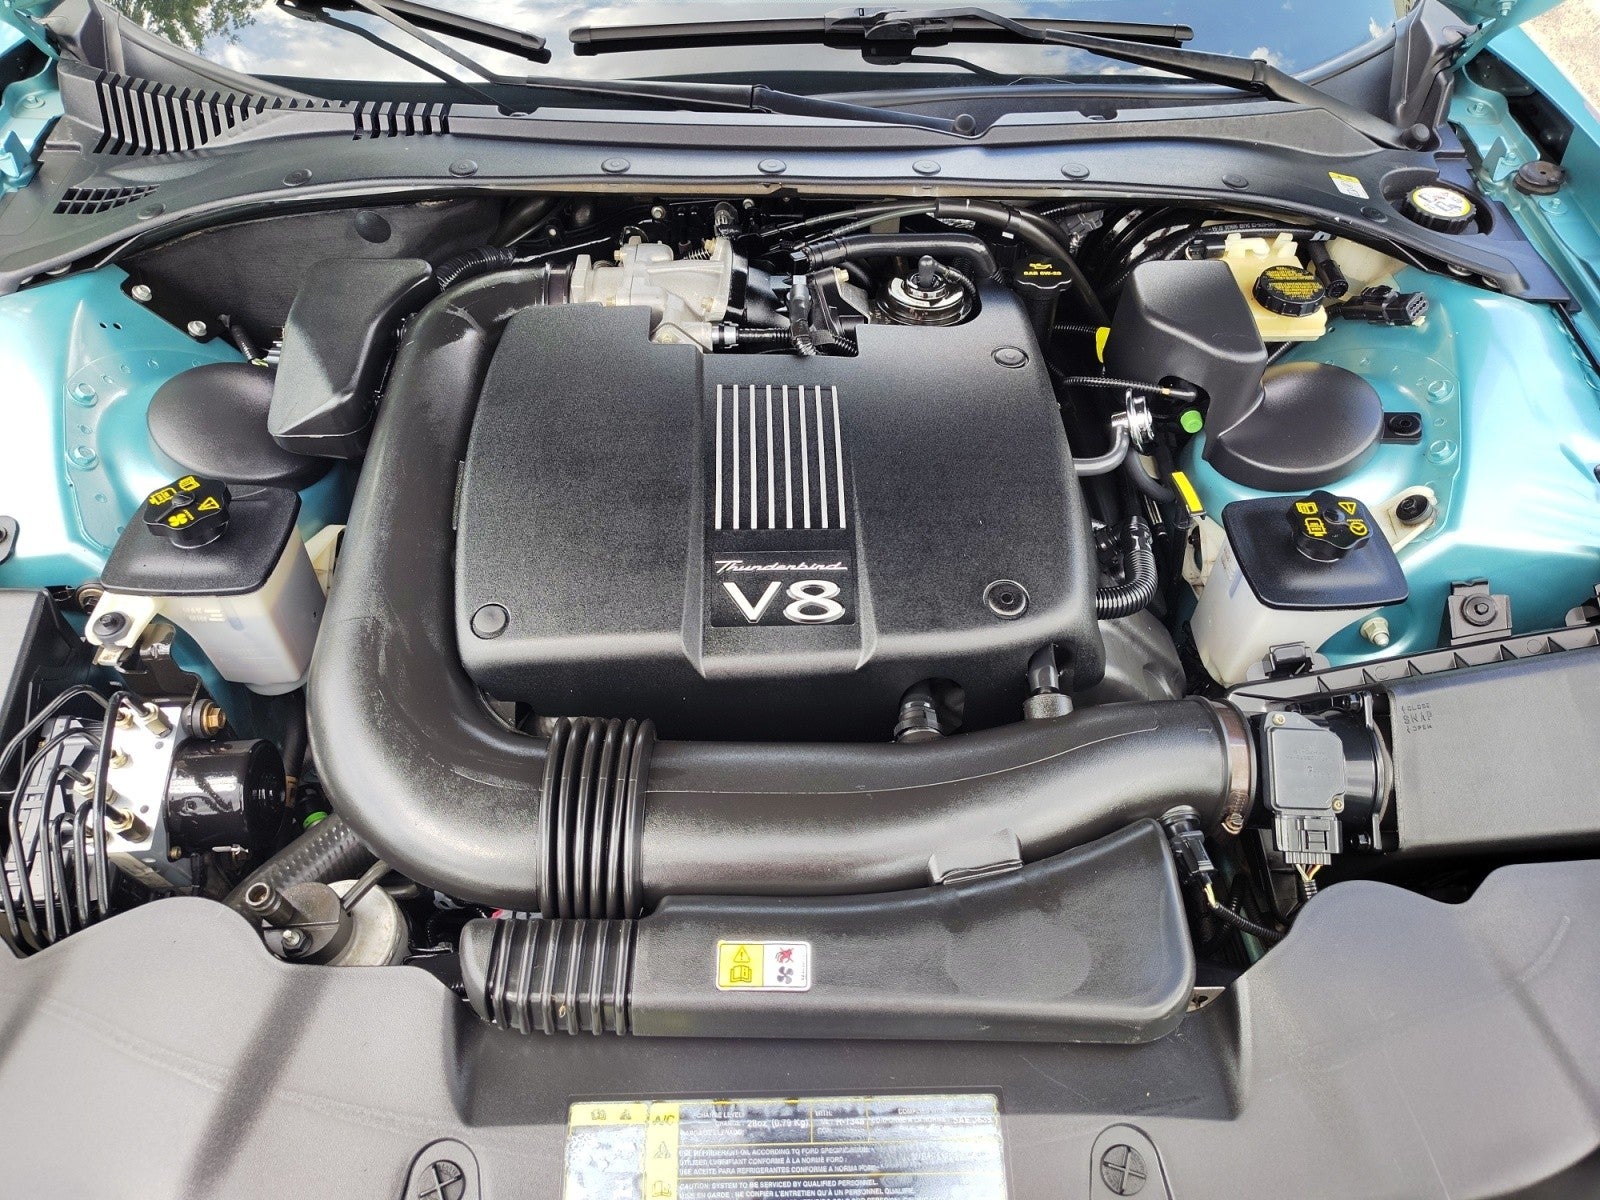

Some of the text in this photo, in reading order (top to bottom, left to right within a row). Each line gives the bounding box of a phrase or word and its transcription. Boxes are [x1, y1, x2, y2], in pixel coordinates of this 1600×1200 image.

[715, 560, 847, 574] Thunderbird
[722, 580, 846, 624] V8
[752, 1148, 790, 1156] ACCORDING
[791, 1148, 800, 1156] TO
[748, 1157, 785, 1165] CONFORME
[775, 1189, 816, 1197] L'ENTRETIEN
